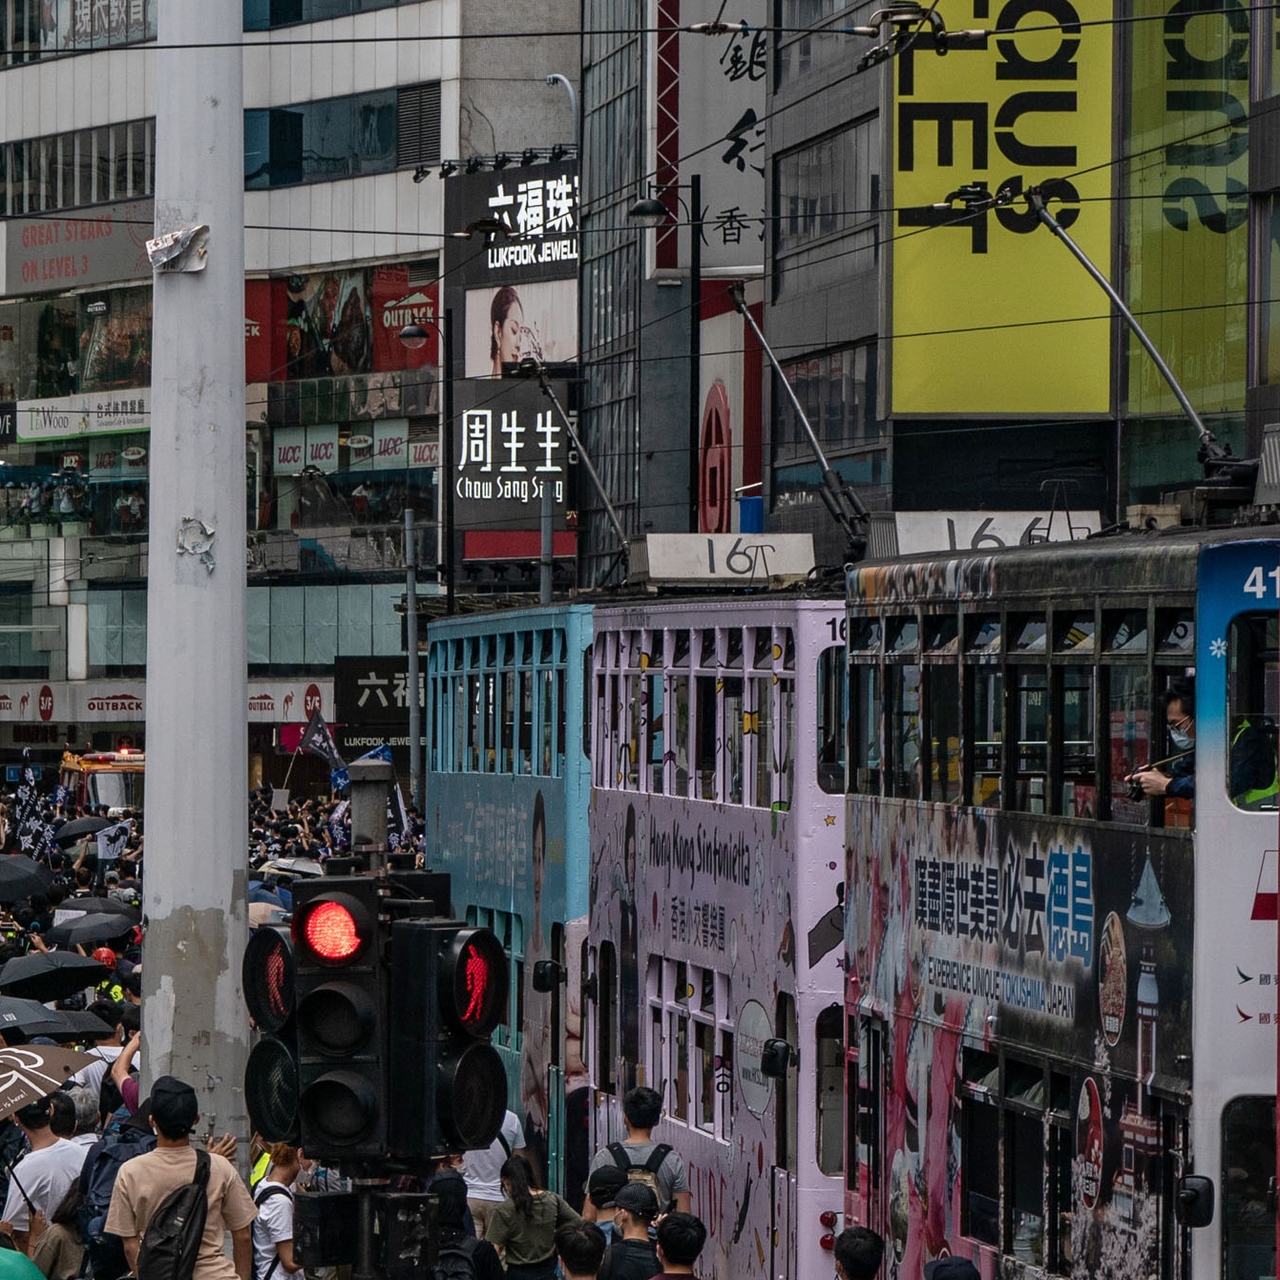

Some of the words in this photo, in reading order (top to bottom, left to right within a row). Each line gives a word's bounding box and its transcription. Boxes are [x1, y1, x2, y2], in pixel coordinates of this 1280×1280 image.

[898, 0, 989, 254] LET
[488, 174, 579, 241] 六福珠
[22, 221, 61, 249] GREAT
[65, 213, 114, 243] STEAKS
[21, 261, 40, 283] ON
[42, 254, 79, 281] LEVEL
[81, 254, 90, 275] 3
[488, 243, 537, 269] LUKFOOK
[310, 442, 334, 461] UCC
[378, 436, 403, 457] UCC
[458, 409, 563, 472] 周生生
[277, 445, 302, 464] UCC
[456, 477, 493, 499] Chow
[496, 475, 528, 503] Sang
[531, 475, 563, 503] Sig
[40, 697, 52, 710] 3/F
[88, 702, 143, 711] OUTBACK
[249, 702, 275, 711] OUTBACK
[344, 737, 384, 746] LUKFOOK
[649, 814, 671, 889] Hong
[672, 822, 695, 890] Kong
[695, 822, 751, 887] Sinfonietta
[927, 960, 972, 994] EXPERIENCE
[972, 974, 1000, 1002] UNIQUE
[1000, 979, 1046, 1010] TOKUSHIMA
[1046, 987, 1074, 1019] JAPAN
